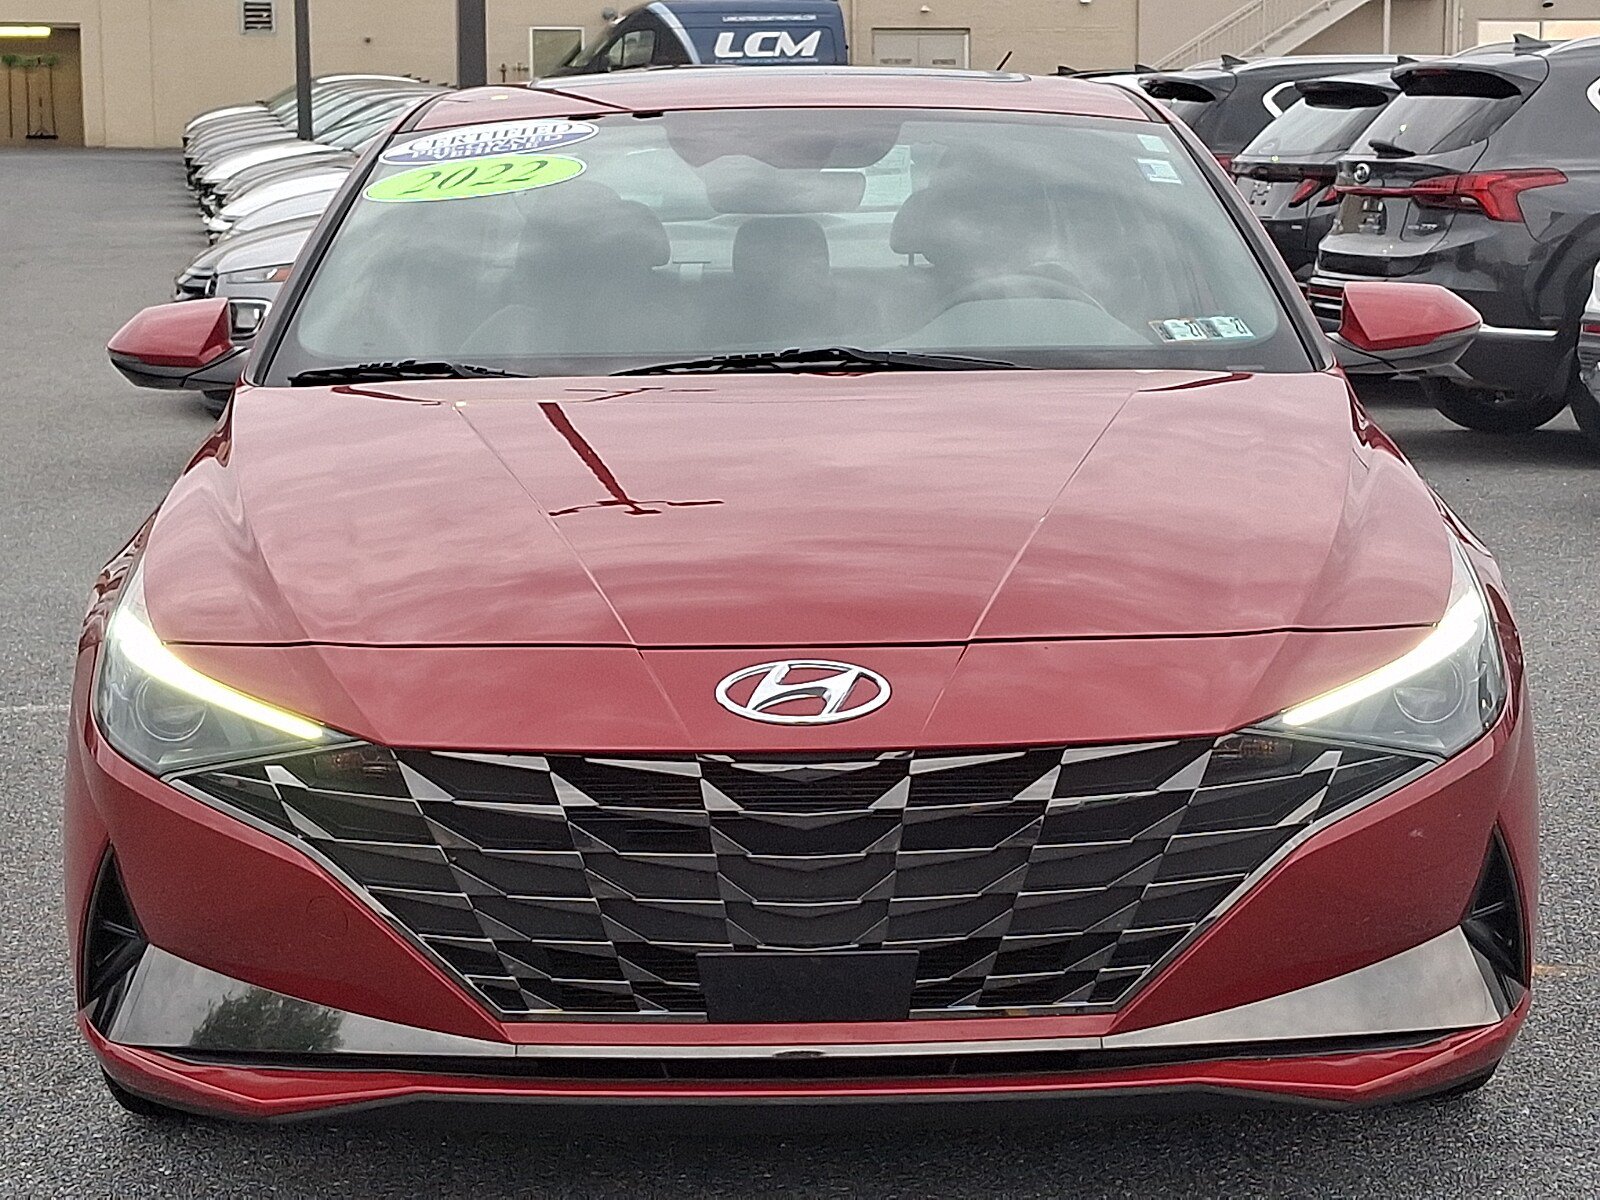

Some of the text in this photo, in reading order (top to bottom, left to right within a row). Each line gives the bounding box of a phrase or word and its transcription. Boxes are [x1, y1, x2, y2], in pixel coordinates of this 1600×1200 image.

[714, 30, 821, 57] LCM
[409, 123, 573, 150] CERTIFIED
[397, 160, 549, 195] 2022
